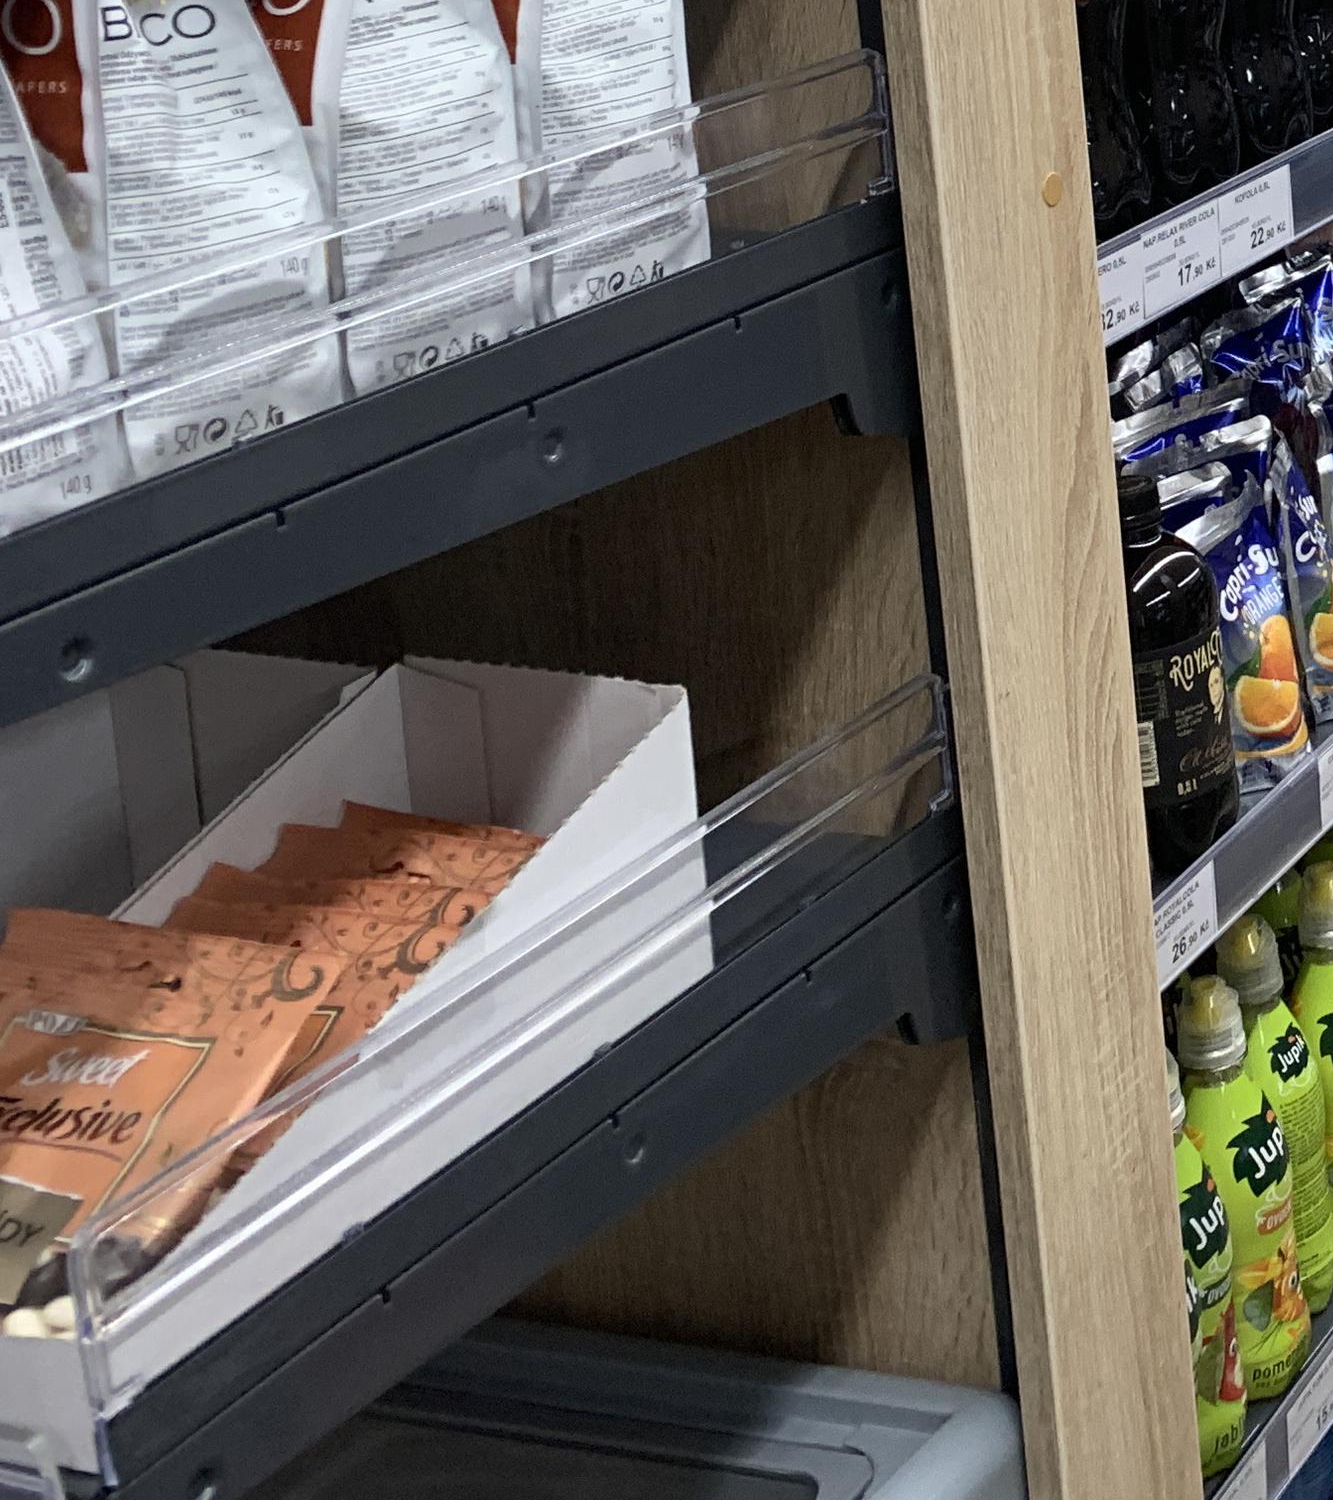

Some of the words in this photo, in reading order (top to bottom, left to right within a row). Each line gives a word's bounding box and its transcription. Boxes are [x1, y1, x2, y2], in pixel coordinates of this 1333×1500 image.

[264, 39, 303, 52] FERS
[14, 80, 68, 94] AFERS
[1250, 226, 1276, 250] 22,90
[1177, 263, 1204, 287] 17,90
[1205, 255, 1217, 271] Kč
[1128, 300, 1140, 316] Kč
[59, 473, 82, 497] 140
[1219, 540, 1280, 622] Capri-Su
[1171, 932, 1199, 965] 26,90
[20, 1046, 152, 1089] Sweet
[1276, 1038, 1305, 1074] Jupik
[0, 1094, 143, 1146] xclusive
[1247, 1130, 1284, 1179] Jup
[1188, 1198, 1226, 1251] Jup
